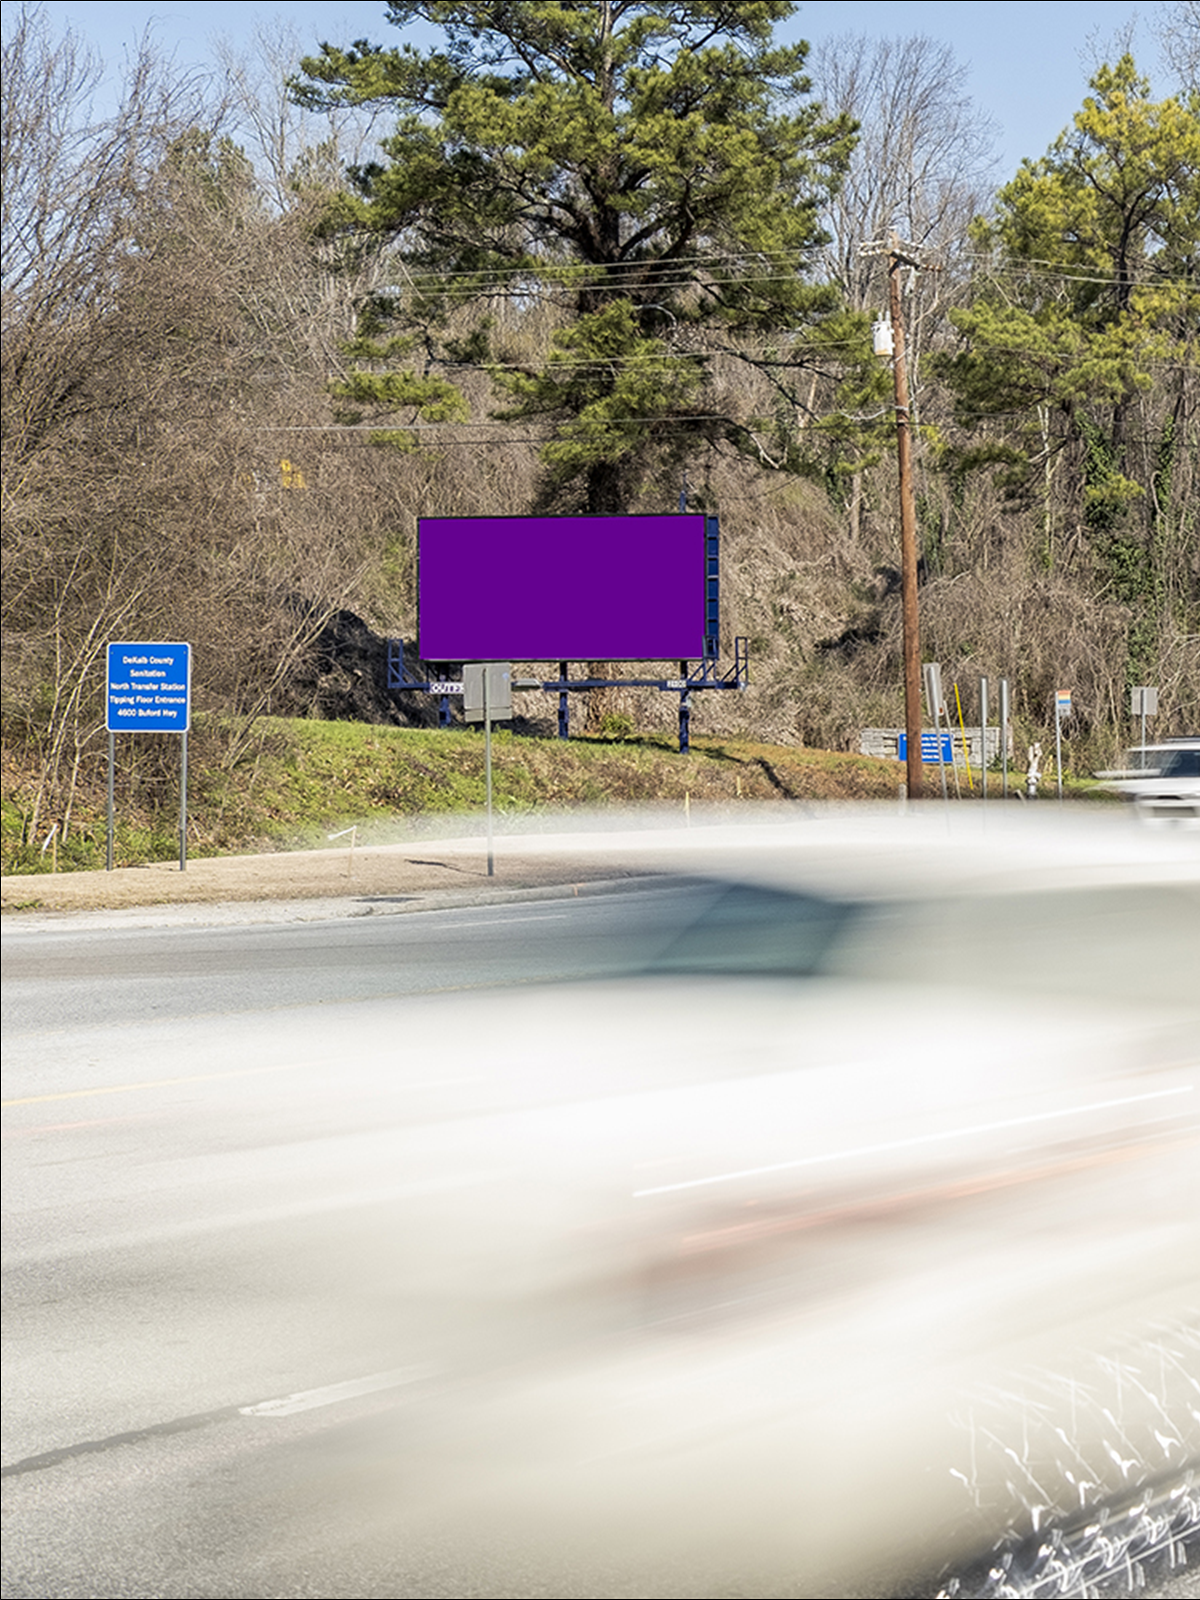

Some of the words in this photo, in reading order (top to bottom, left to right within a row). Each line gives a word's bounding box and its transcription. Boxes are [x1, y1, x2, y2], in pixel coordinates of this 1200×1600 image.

[149, 656, 174, 666] County
[130, 669, 166, 677] Sanitation
[110, 682, 130, 690] North
[131, 682, 159, 690] Transfer
[160, 682, 186, 691] Station
[110, 695, 135, 705] Tipping
[136, 696, 153, 704] Floor
[154, 696, 186, 704] Entrance
[138, 708, 161, 717] Buford
[162, 708, 178, 719] Hwy
